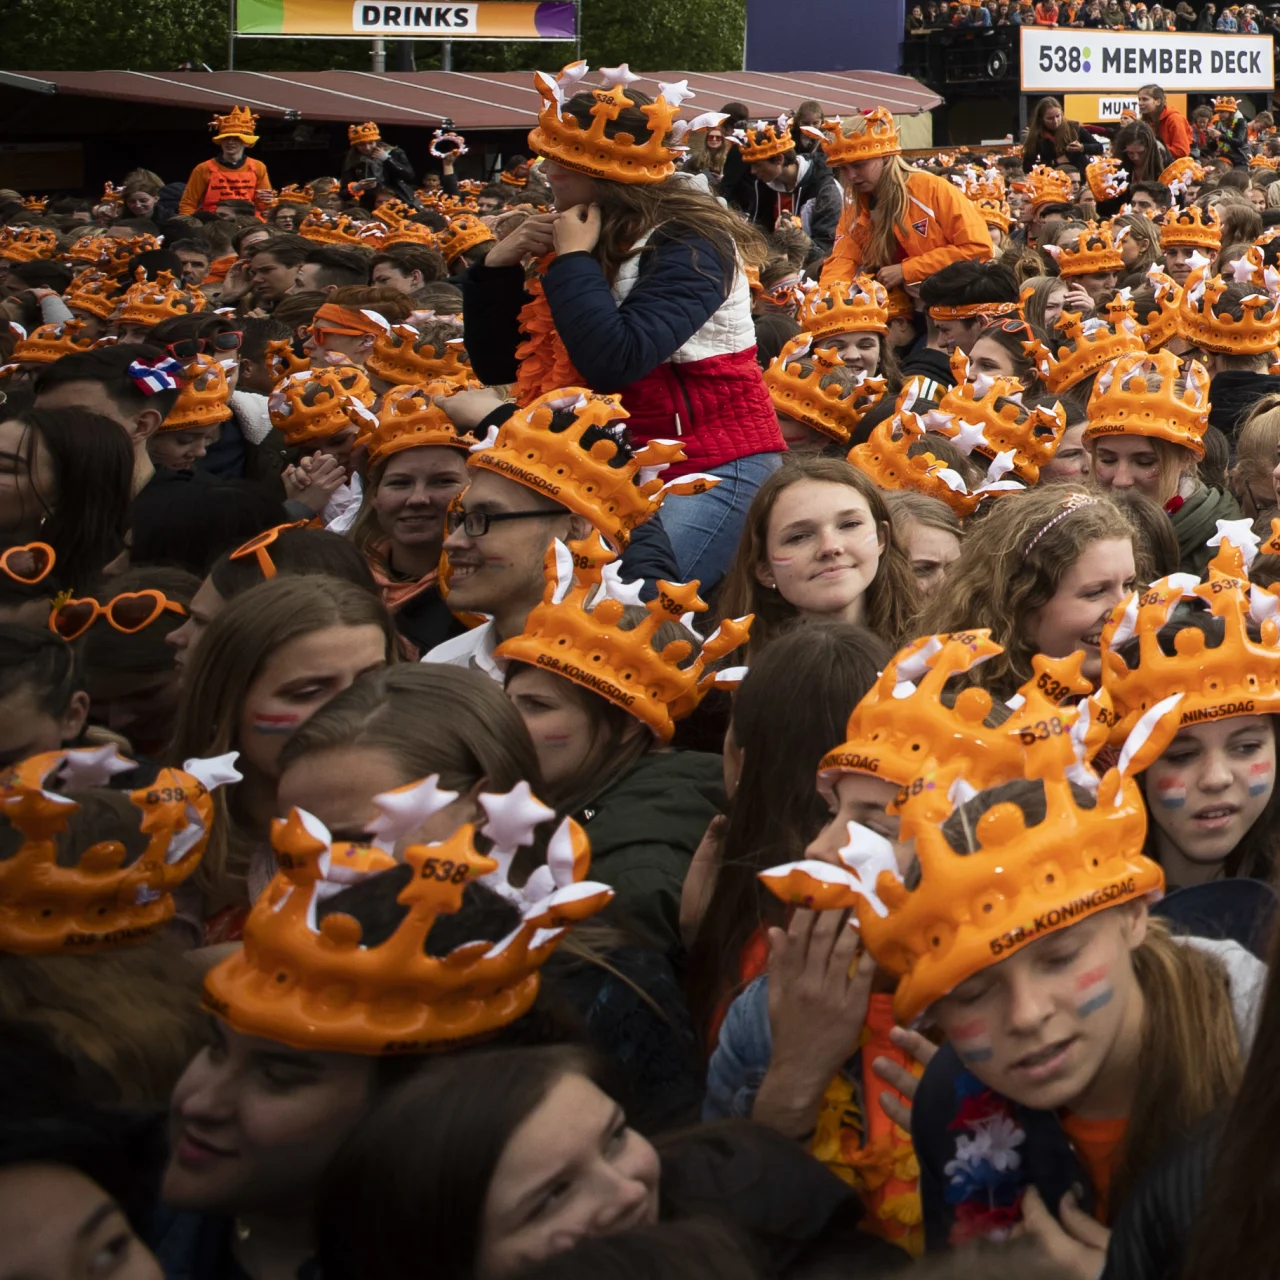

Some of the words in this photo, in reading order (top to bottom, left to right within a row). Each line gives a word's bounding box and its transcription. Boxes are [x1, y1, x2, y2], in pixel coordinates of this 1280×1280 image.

[362, 5, 469, 28] DRINKS
[1102, 47, 1202, 74] MEMBER
[1211, 51, 1261, 74] DECK
[551, 154, 605, 177] KONINGSDAG
[1112, 305, 1126, 313] 538
[496, 459, 562, 496] KONINGSDAG
[1210, 578, 1240, 594] 538
[660, 591, 684, 616] 538
[536, 653, 559, 670] 538
[562, 664, 636, 708] KONINGSDAG
[1036, 672, 1071, 701] 538
[1019, 717, 1064, 746] 538
[146, 787, 185, 804] 538
[421, 858, 470, 885] 538
[989, 926, 1027, 956] 538
[1033, 878, 1137, 933] KONINGSDAG
